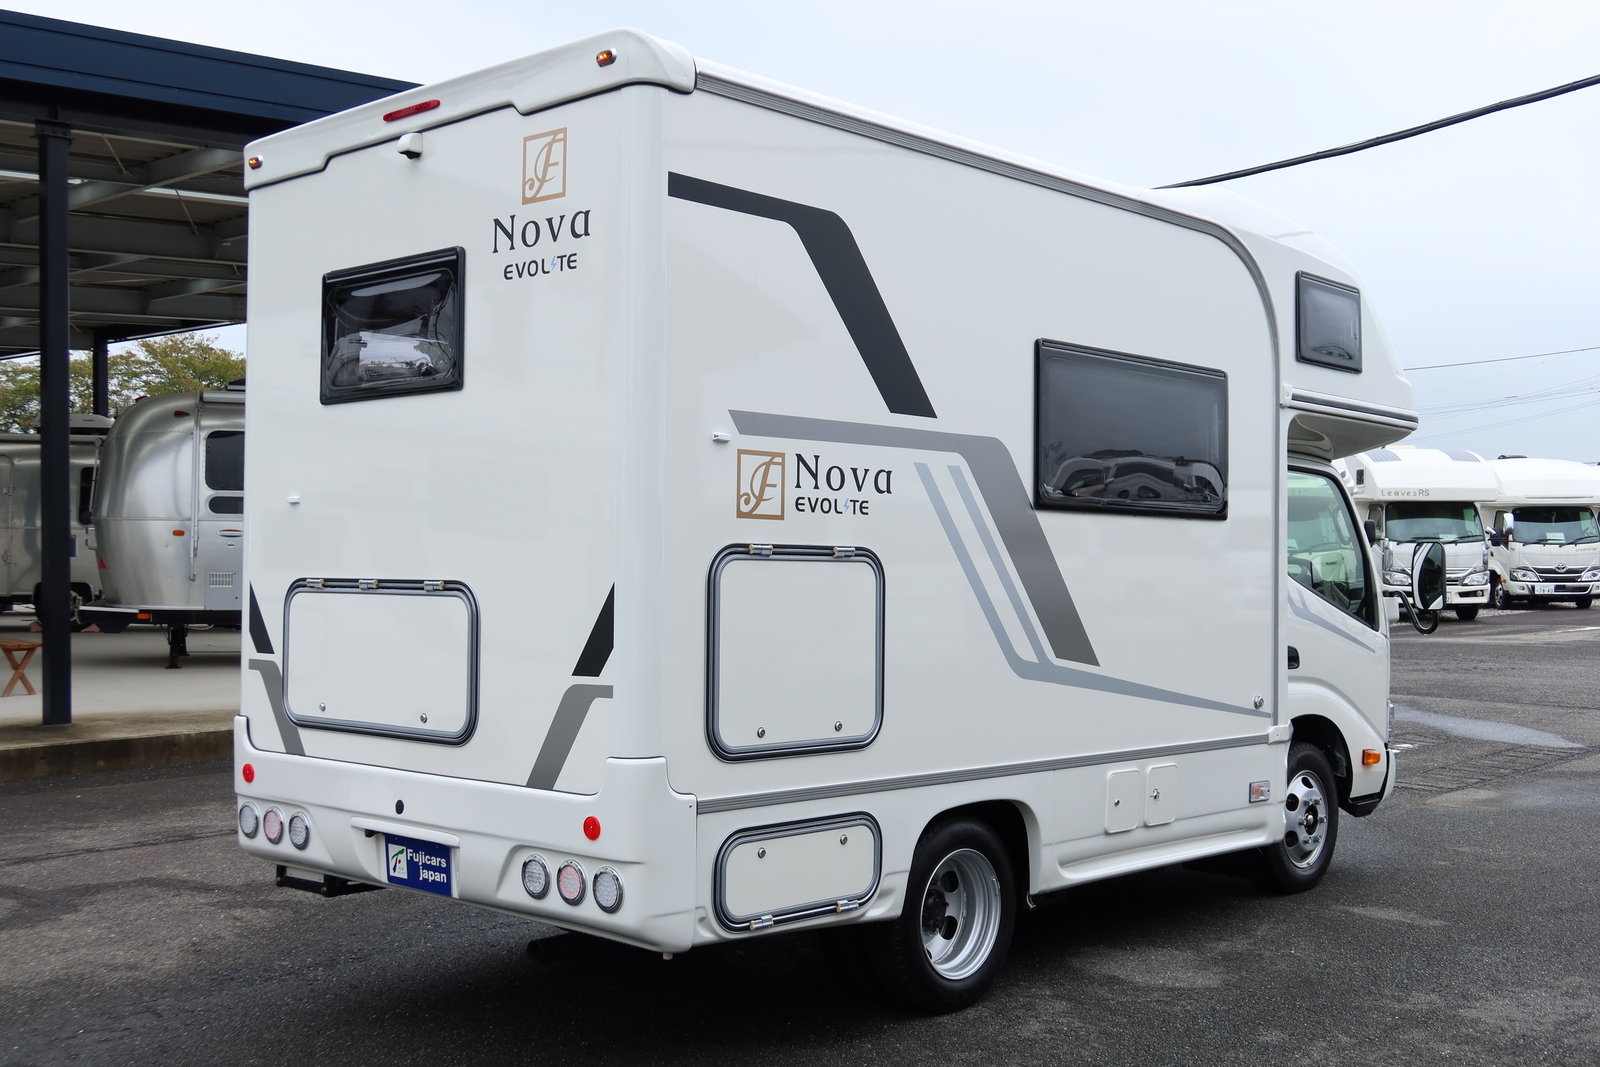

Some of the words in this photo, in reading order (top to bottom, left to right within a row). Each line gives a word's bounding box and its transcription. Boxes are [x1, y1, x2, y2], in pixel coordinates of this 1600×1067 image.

[492, 209, 591, 254] Nova
[795, 453, 893, 494] Nova
[407, 848, 447, 868] Fujicars
[419, 866, 447, 883] japan
